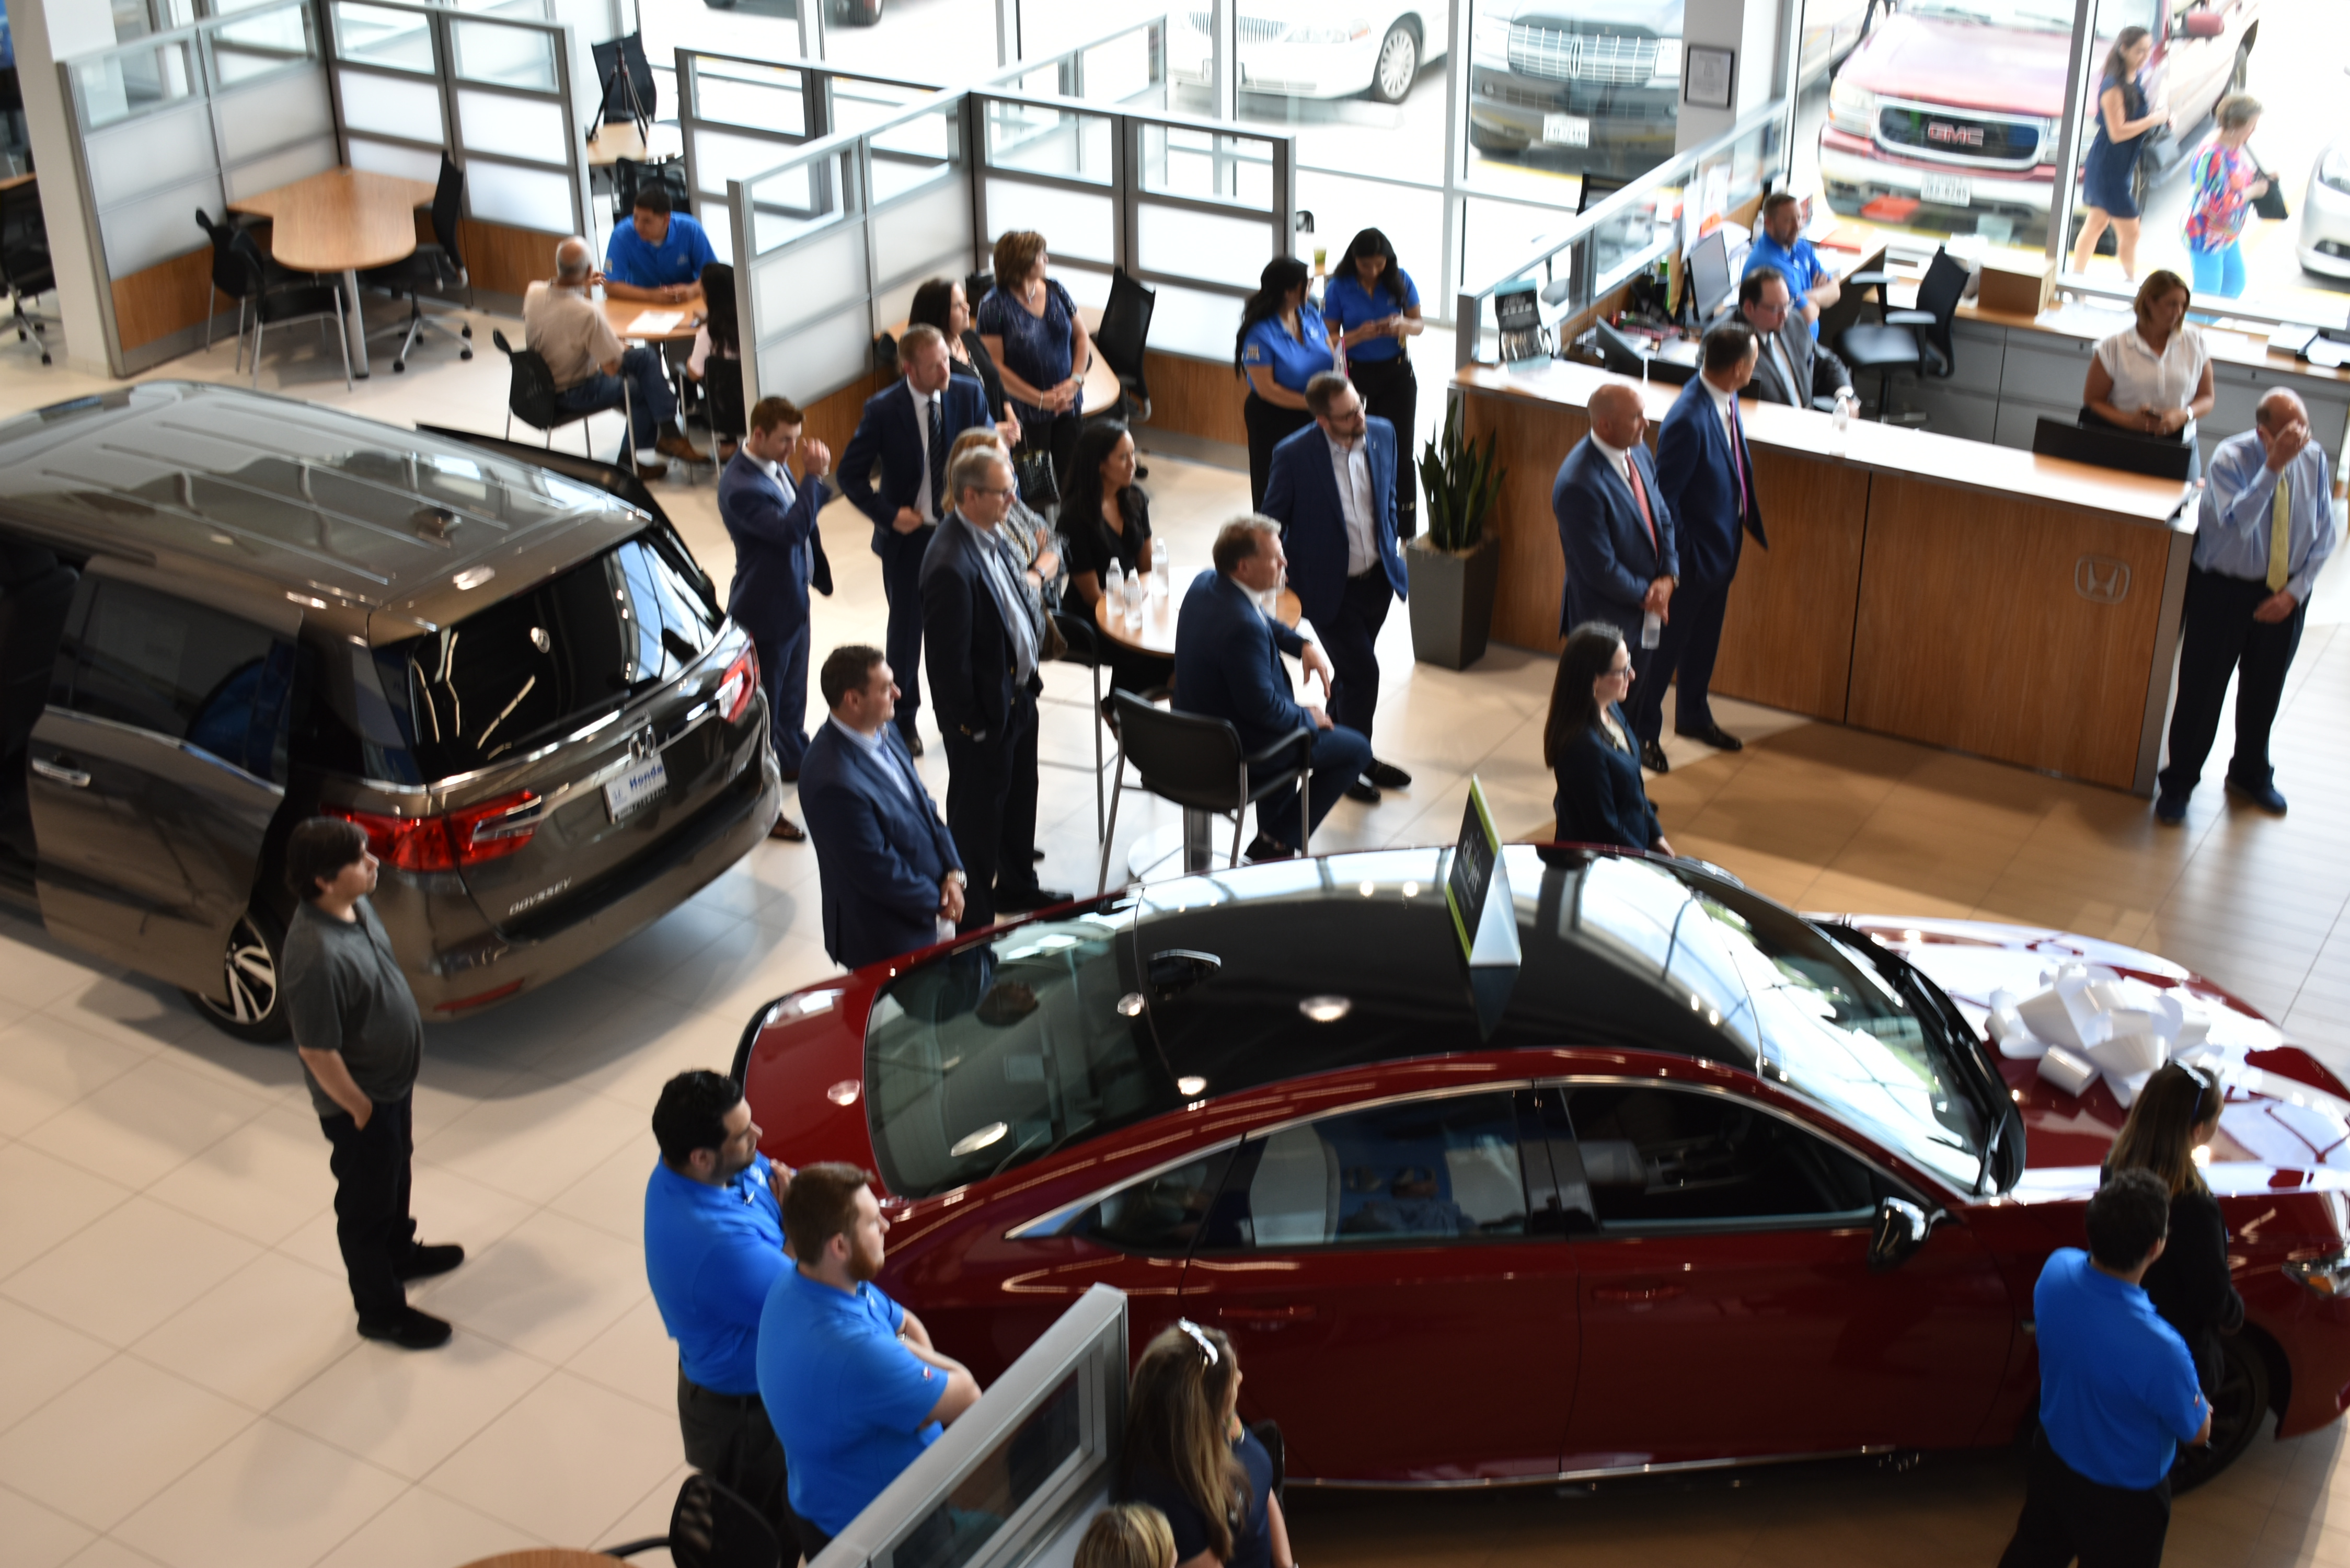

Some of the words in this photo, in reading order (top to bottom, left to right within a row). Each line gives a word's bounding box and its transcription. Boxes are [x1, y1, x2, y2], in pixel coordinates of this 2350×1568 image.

[1928, 122, 1984, 147] GMC
[629, 765, 663, 790] Honda
[510, 876, 572, 915] ODYSSEY
